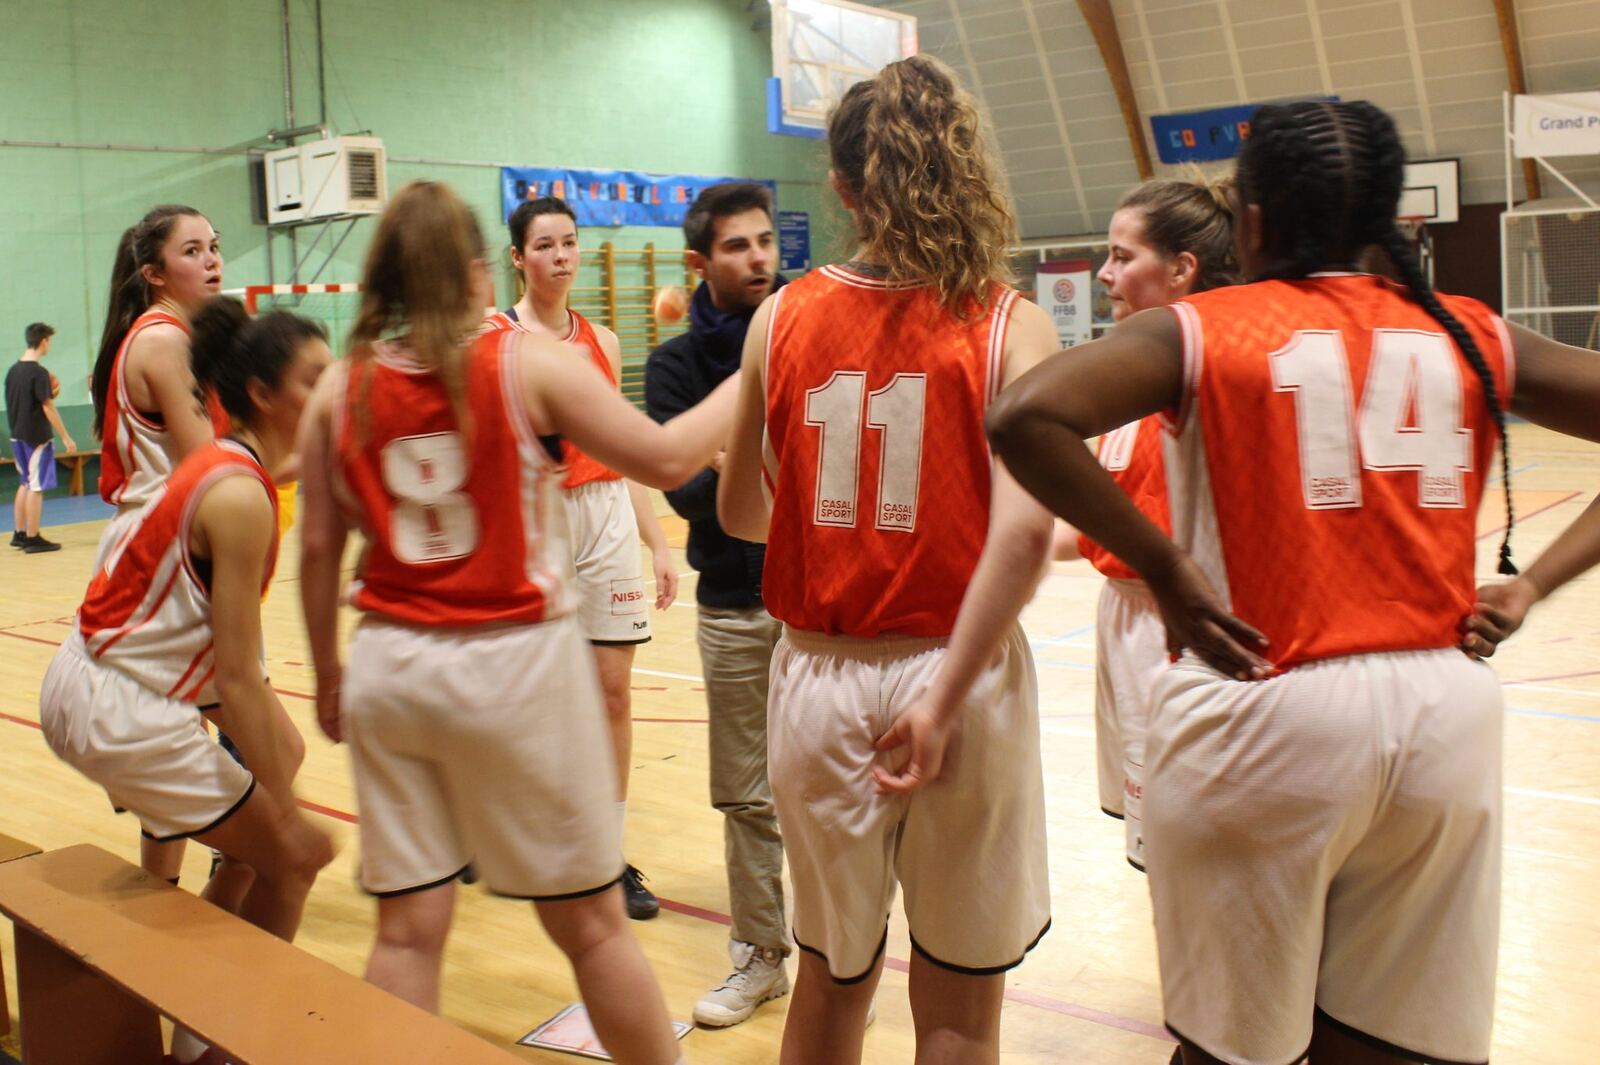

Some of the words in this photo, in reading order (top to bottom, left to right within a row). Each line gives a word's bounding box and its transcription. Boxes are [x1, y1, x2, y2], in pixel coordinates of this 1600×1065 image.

[1540, 116, 1583, 130] Grand
[1267, 328, 1474, 510] 14
[804, 370, 928, 533] 11
[380, 430, 481, 565] 8
[821, 499, 852, 510] CASAL
[883, 503, 913, 514] CASAL
[821, 509, 852, 519] SPORT
[883, 512, 912, 522] SPORT
